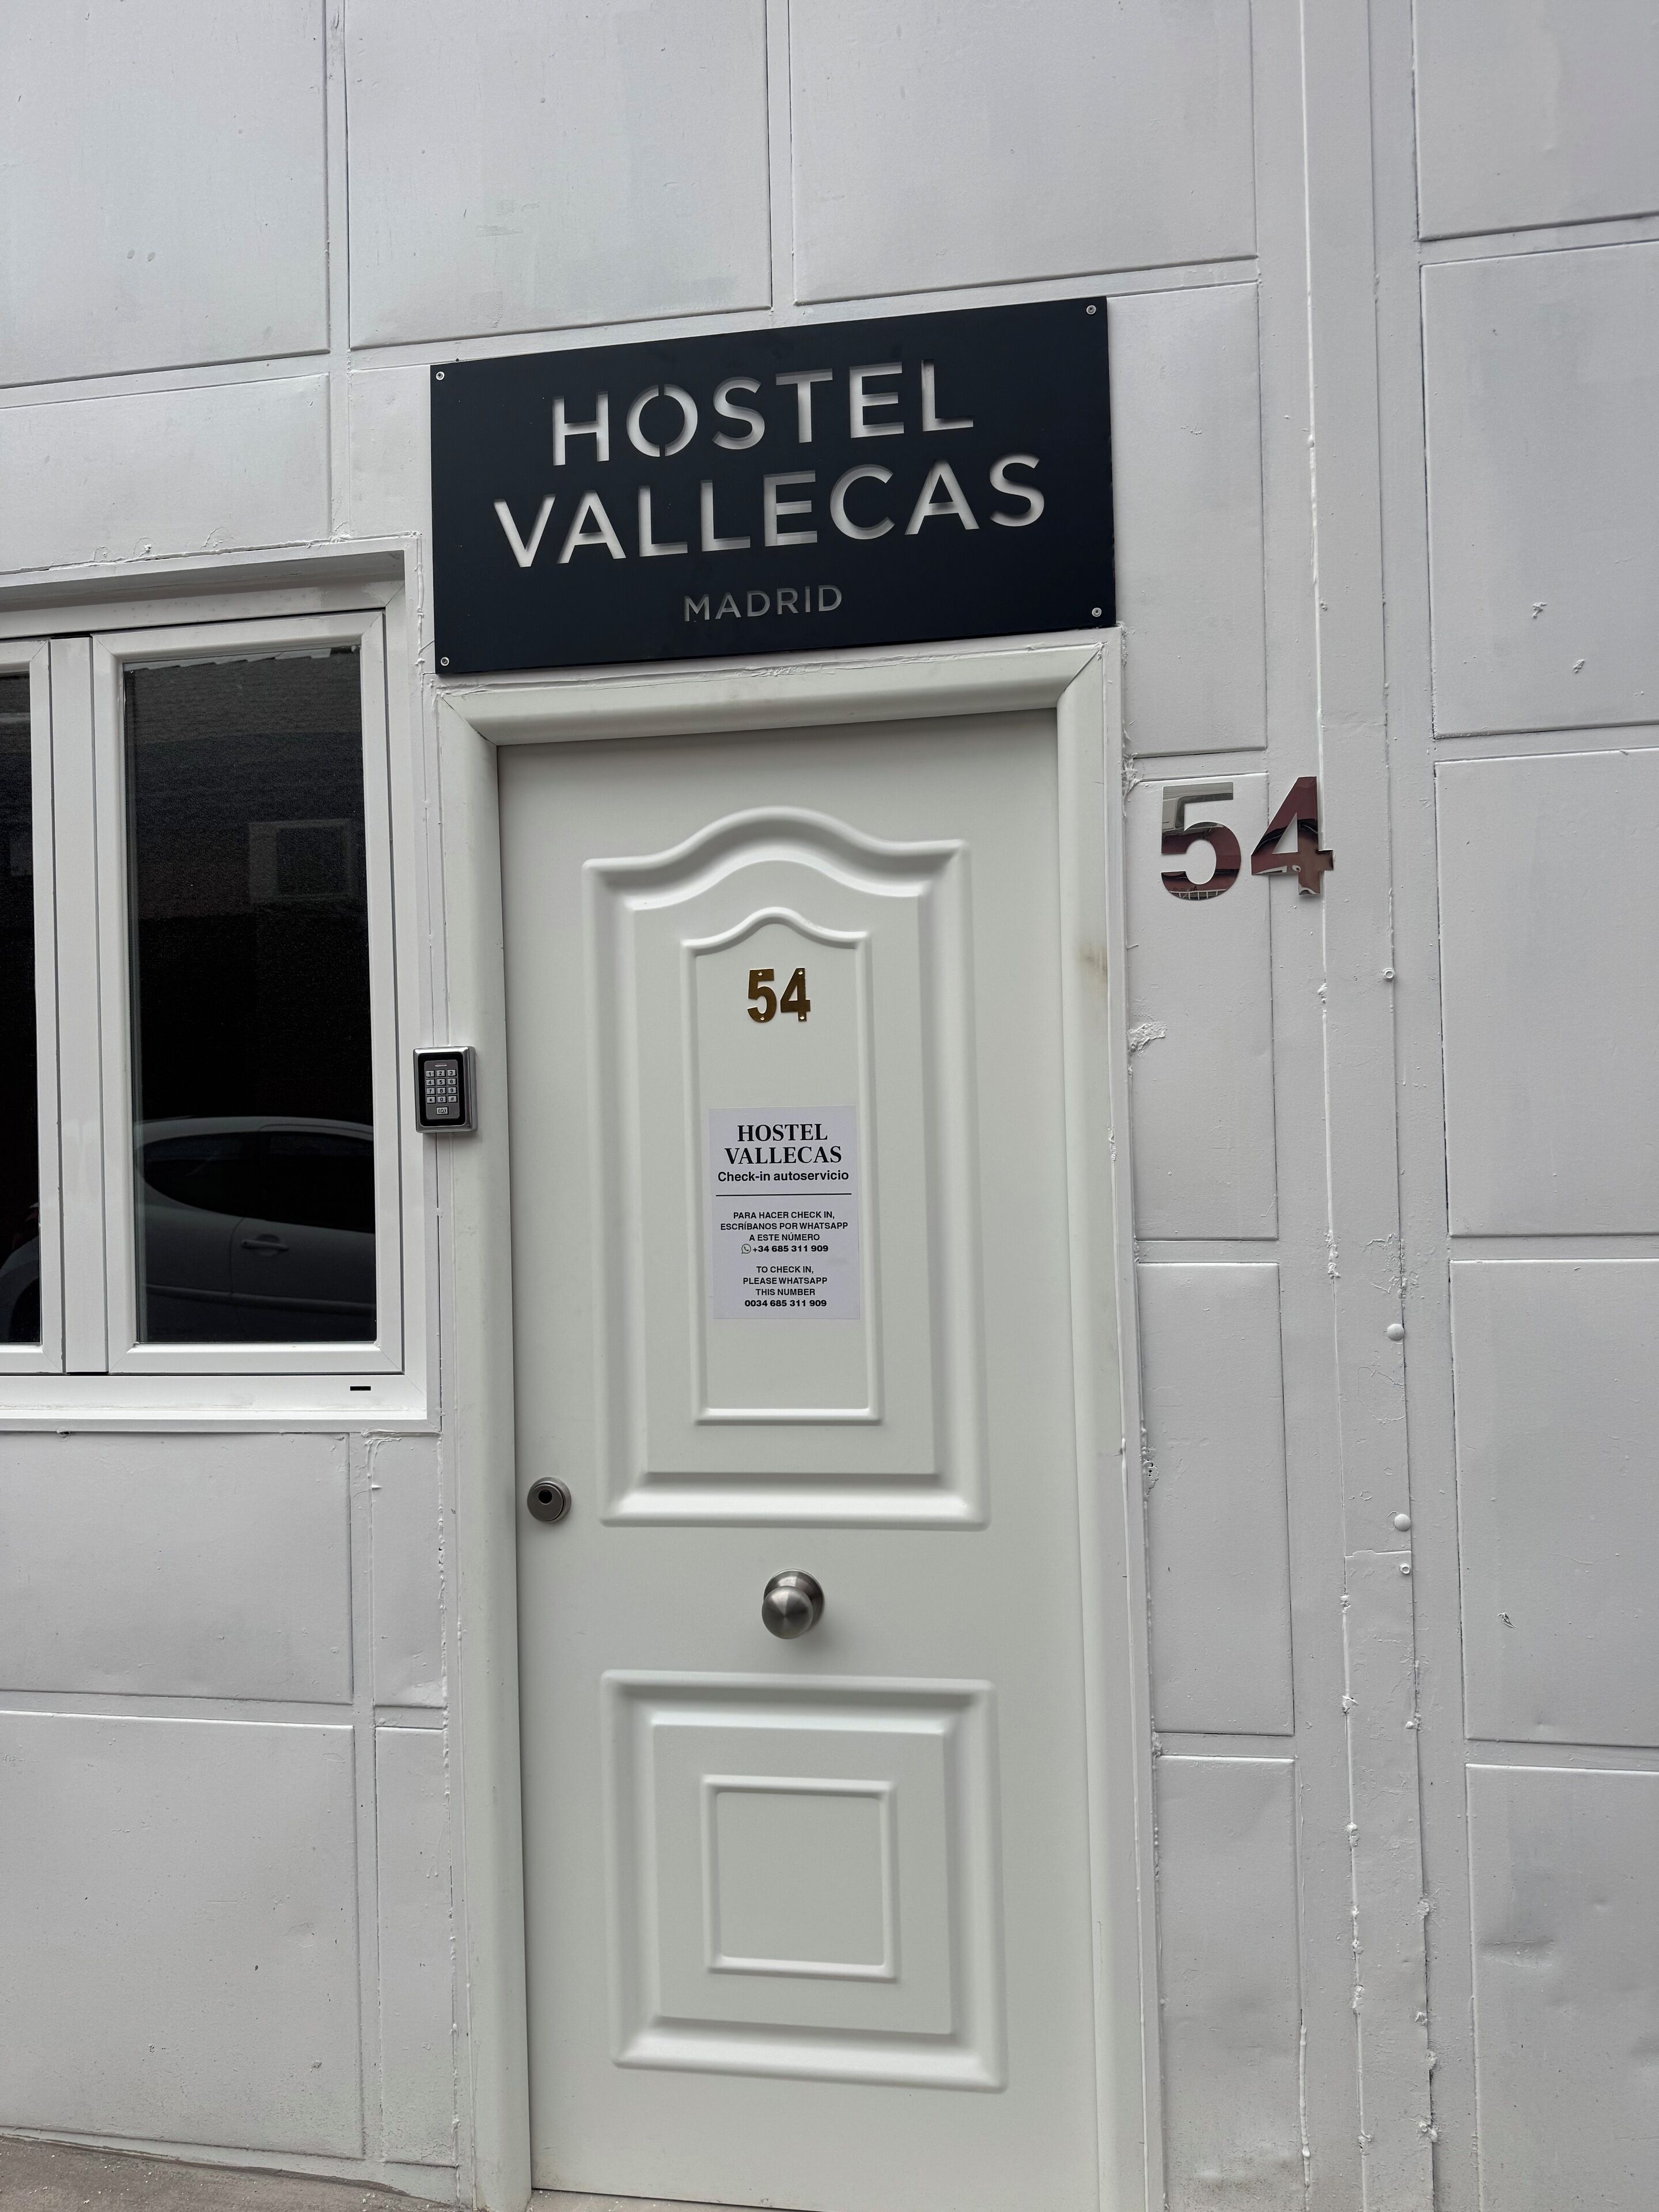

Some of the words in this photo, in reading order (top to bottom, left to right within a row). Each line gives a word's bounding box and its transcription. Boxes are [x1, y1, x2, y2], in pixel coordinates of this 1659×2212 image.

[552, 358, 975, 467] HOSTEL
[494, 453, 1046, 569] VALLECAS
[684, 585, 843, 623] MADRID
[1161, 776, 1334, 901] 54
[747, 968, 810, 1023] 54
[737, 1123, 828, 1142] HOSTEL
[725, 1146, 842, 1165] VALLECAS
[718, 1171, 770, 1181] Check-in
[774, 1170, 849, 1181] autoservicio
[824, 1211, 835, 1219] IN,
[721, 1222, 777, 1230] ESCRÍBANOS
[782, 1232, 820, 1241] NÚMERO
